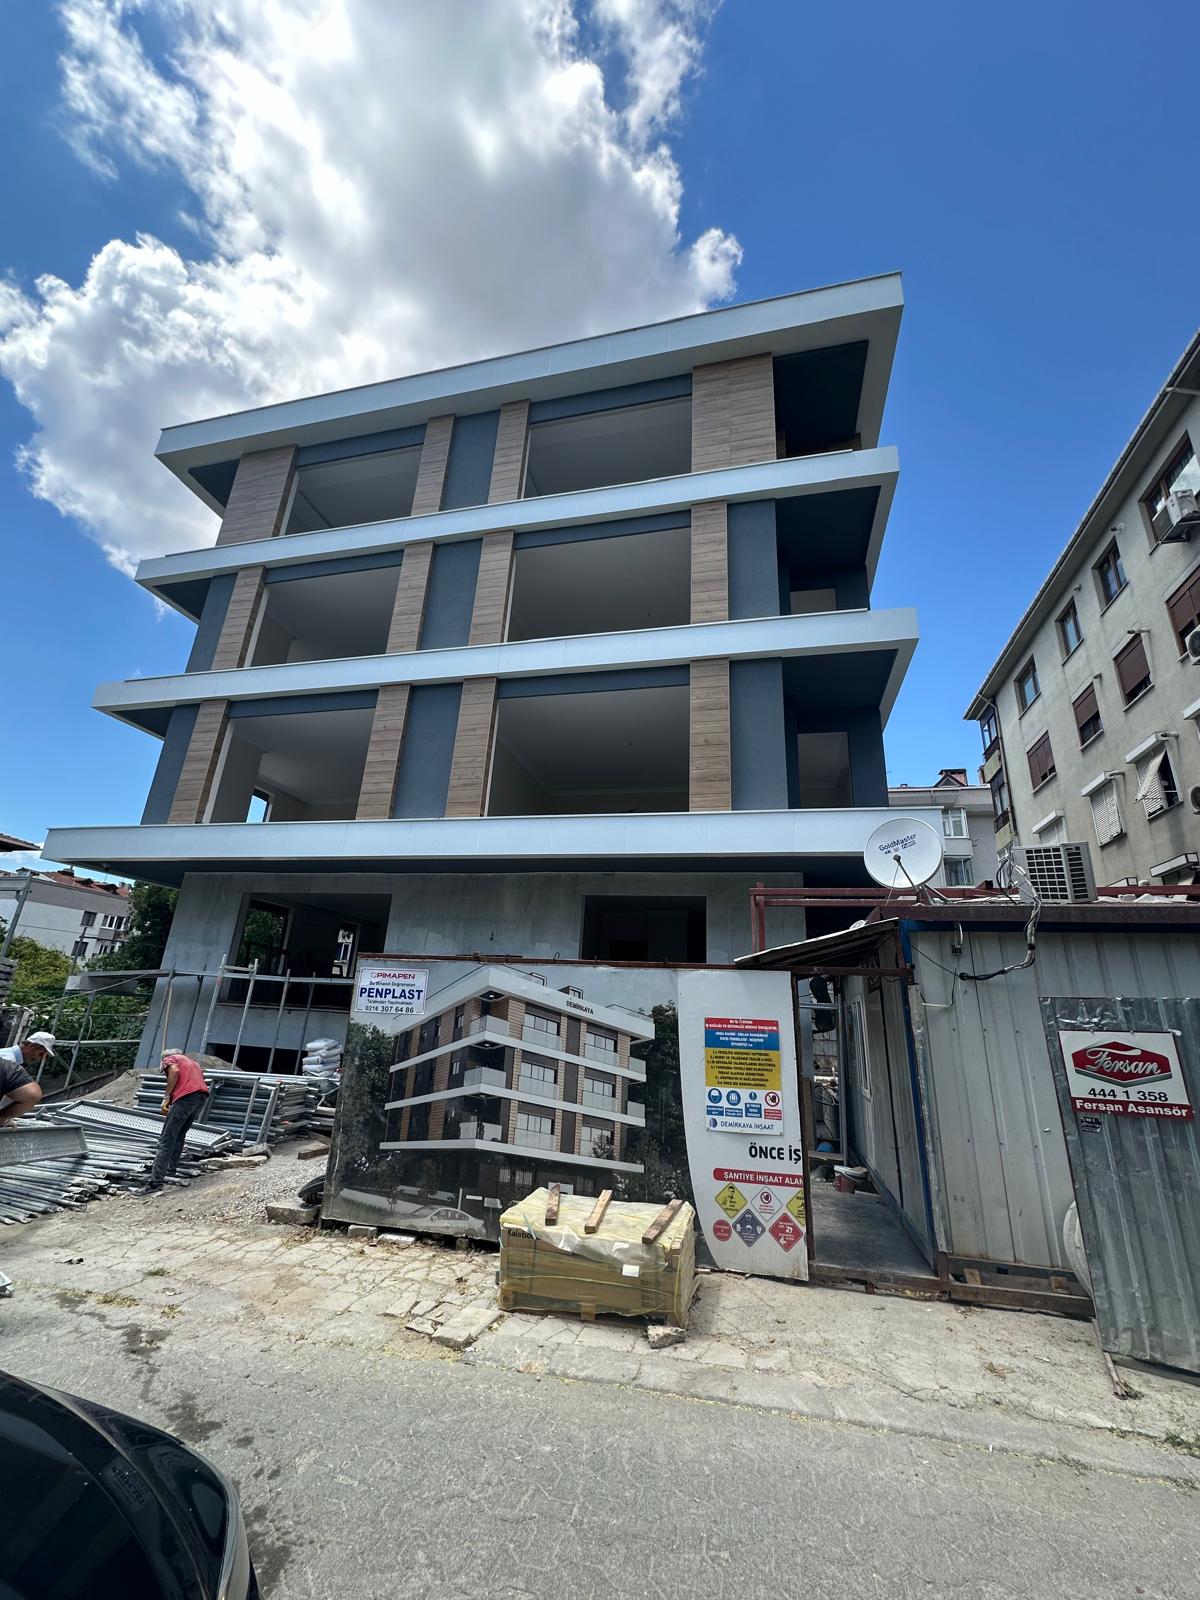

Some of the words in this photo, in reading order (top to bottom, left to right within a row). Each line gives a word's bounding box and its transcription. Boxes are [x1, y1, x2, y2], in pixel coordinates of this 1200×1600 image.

[879, 833, 916, 851] GoldMaster
[360, 987, 423, 1000] PENPLAST
[405, 1006, 415, 1014] 86
[1086, 1047, 1161, 1075] Fersan
[1088, 1087, 1117, 1099] 444
[1122, 1090, 1131, 1100] 1
[1138, 1090, 1169, 1102] 358
[1075, 1099, 1123, 1112] Fersan
[1127, 1103, 1188, 1117] Asansör
[720, 1121, 753, 1129] DEMİRKAYA
[748, 1142, 785, 1160] ÖNCE
[723, 1171, 755, 1182] ŞANTİYE
[756, 1172, 783, 1184] İNŞAAT
